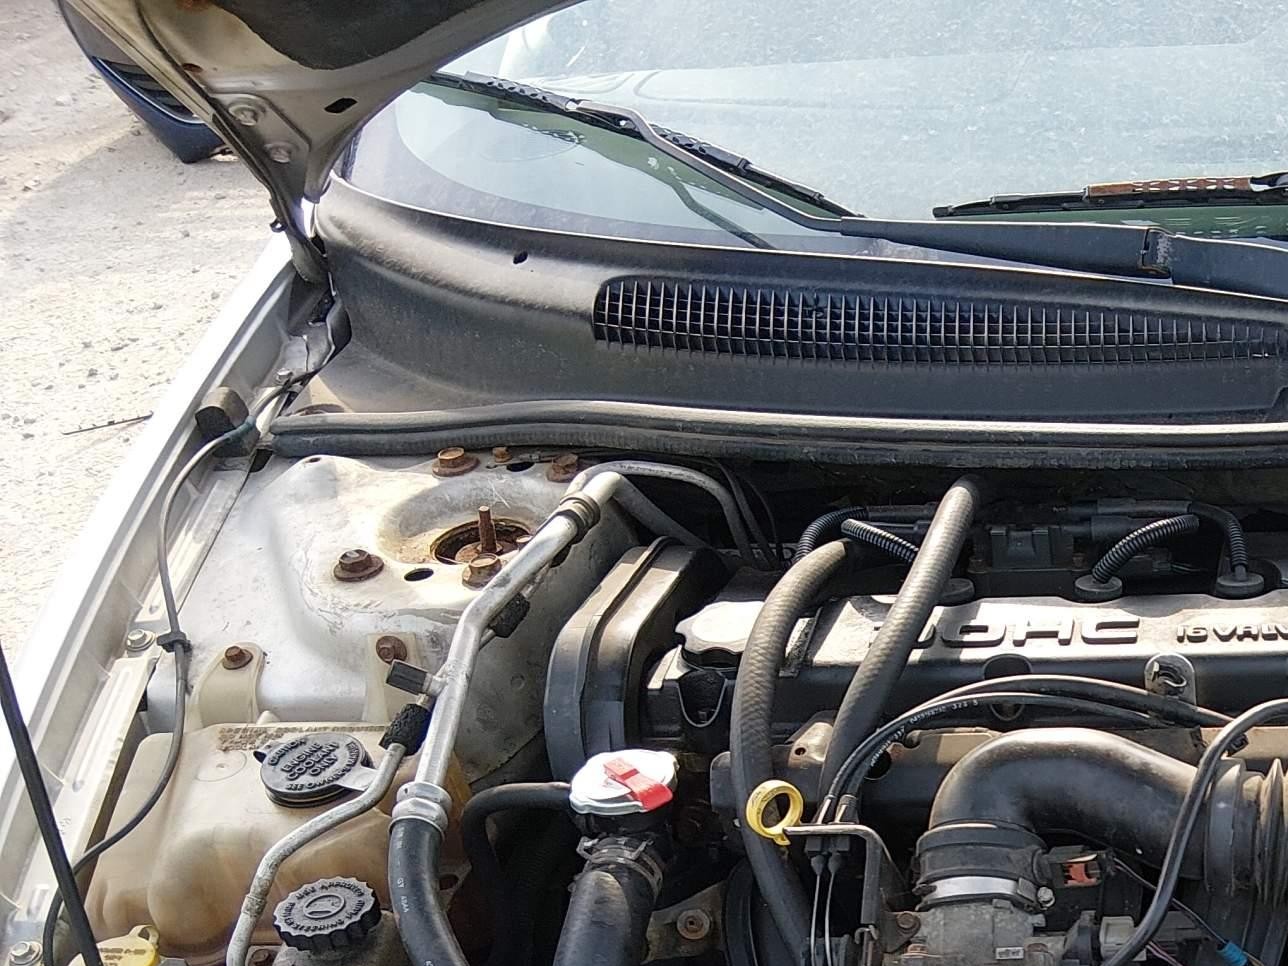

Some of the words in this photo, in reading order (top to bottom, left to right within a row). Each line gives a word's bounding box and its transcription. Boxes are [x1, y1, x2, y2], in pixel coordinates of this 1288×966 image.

[868, 617, 1140, 648] OHC
[267, 737, 307, 766] CAUTION
[281, 742, 323, 773] ENGINE
[285, 742, 340, 781] COOLANT
[308, 754, 339, 777] ONLY
